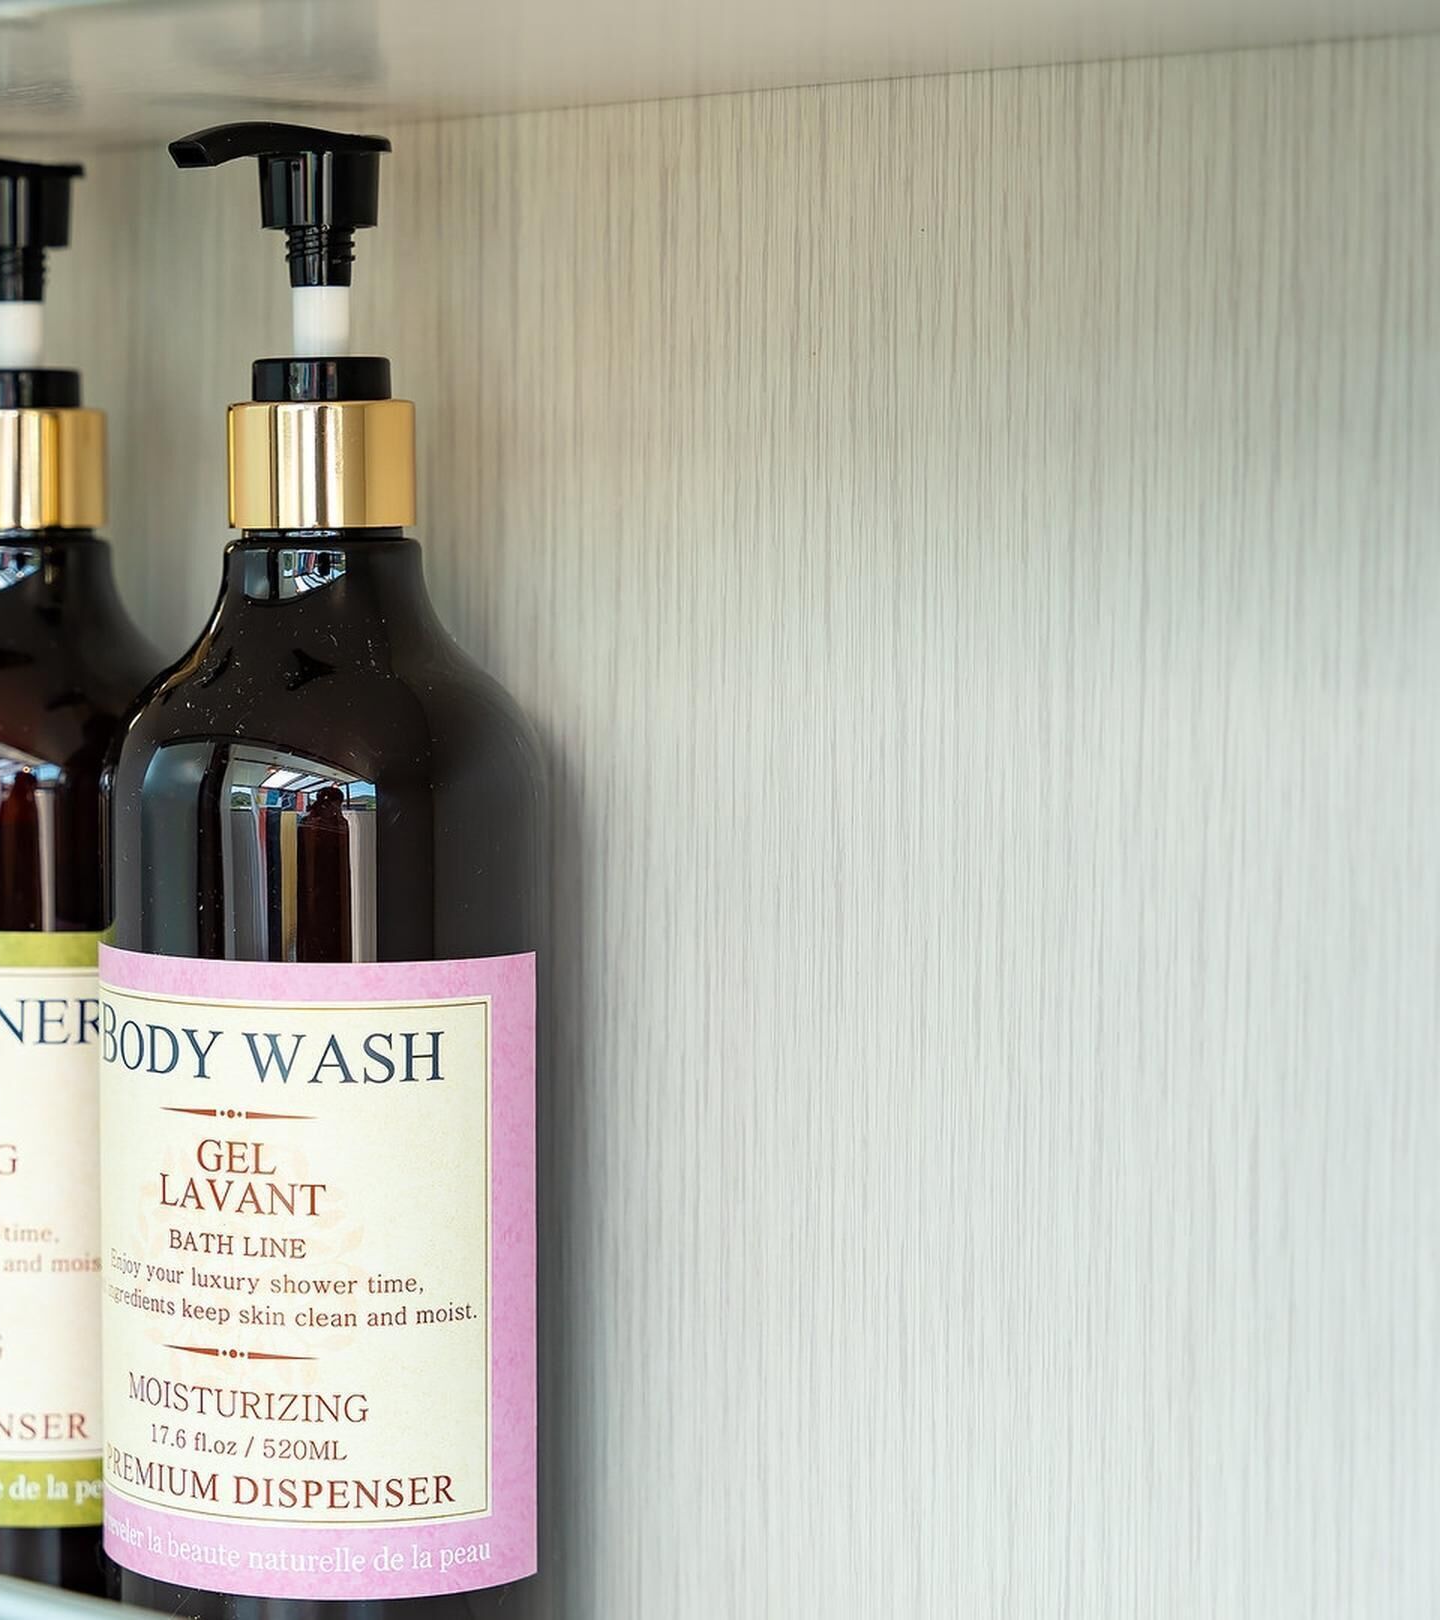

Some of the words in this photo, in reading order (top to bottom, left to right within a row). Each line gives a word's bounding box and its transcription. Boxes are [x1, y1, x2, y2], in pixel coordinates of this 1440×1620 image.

[101, 1001, 223, 1080] BODY
[242, 1031, 445, 1084] WASH
[197, 1139, 277, 1176] GEL
[160, 1172, 327, 1217] LAVANT
[3, 1250, 44, 1273] and
[51, 1250, 102, 1273] mois
[169, 1228, 235, 1258] BATH
[243, 1235, 307, 1259] LINE
[110, 1247, 141, 1278] Enjoy
[146, 1264, 184, 1284] your
[191, 1266, 260, 1295] luxury
[270, 1271, 358, 1294] shower
[368, 1271, 424, 1294] time,
[108, 1284, 176, 1316] ngredients
[182, 1298, 230, 1325] keep
[239, 1304, 286, 1327] skin
[295, 1305, 357, 1327] clean
[367, 1304, 407, 1327] and
[415, 1302, 478, 1325] moist.
[128, 1371, 369, 1424] MOISTURIZING
[150, 1423, 187, 1449] 17.6
[194, 1431, 237, 1456] fl.oz
[244, 1437, 253, 1458] /
[263, 1438, 348, 1461] 520ML
[9, 1473, 40, 1499] de
[46, 1475, 69, 1499] la
[75, 1479, 102, 1505] pe
[106, 1442, 219, 1502] PREMIUM
[233, 1475, 456, 1509] DISPENSER
[147, 1526, 161, 1554] la
[167, 1530, 240, 1567] beaute
[248, 1545, 366, 1573] naturelle
[373, 1543, 404, 1572] de
[411, 1541, 432, 1569] la
[440, 1538, 491, 1571] peau
